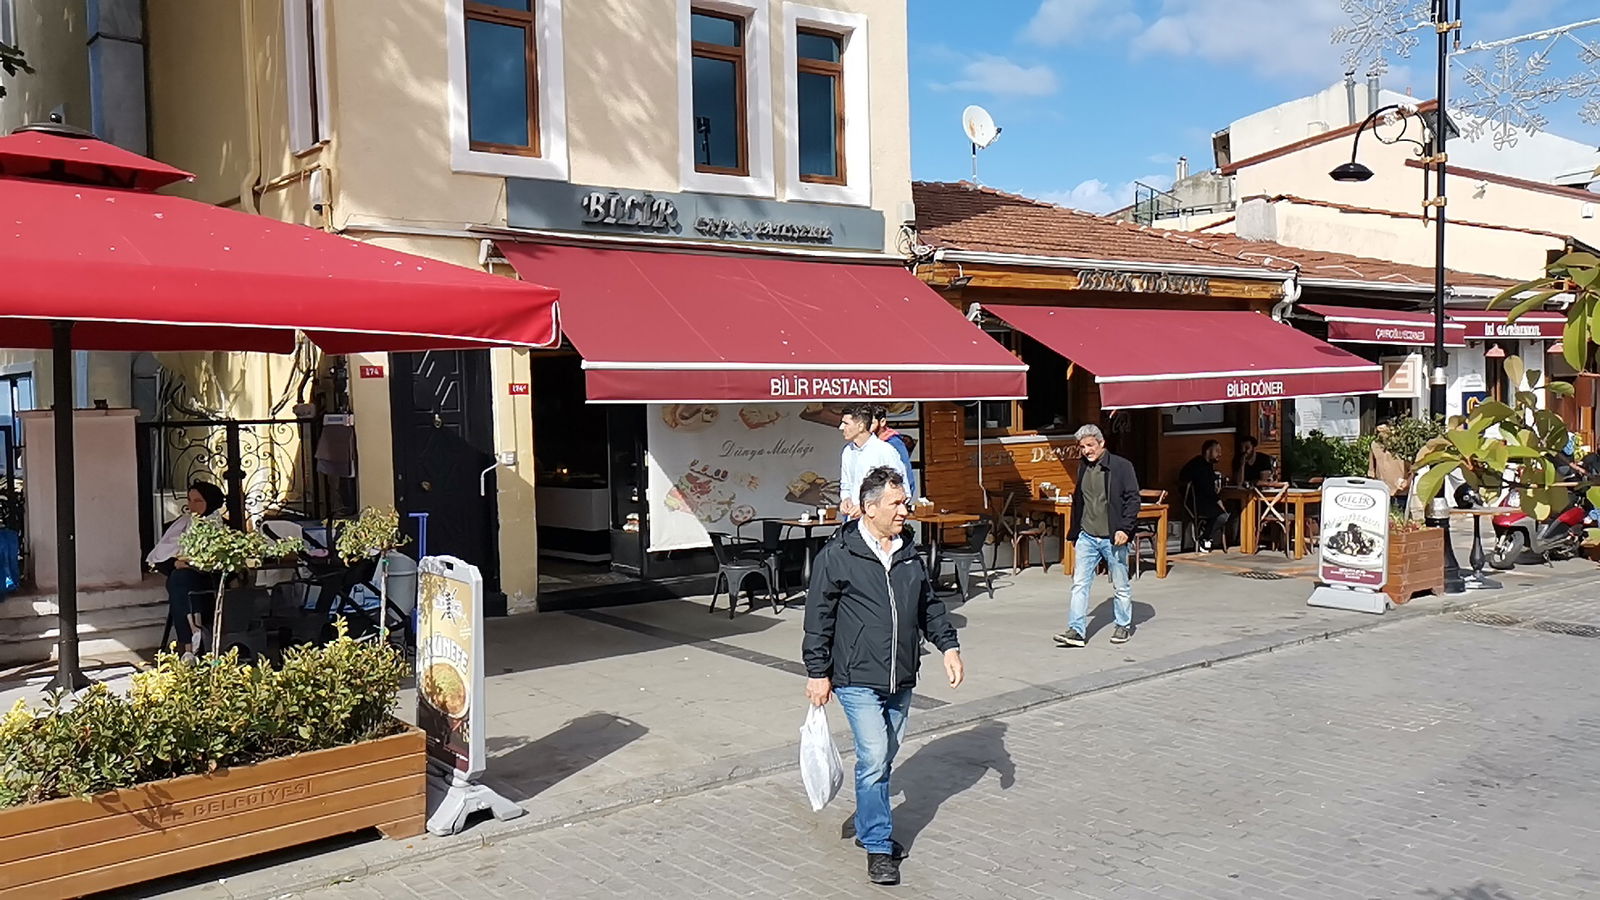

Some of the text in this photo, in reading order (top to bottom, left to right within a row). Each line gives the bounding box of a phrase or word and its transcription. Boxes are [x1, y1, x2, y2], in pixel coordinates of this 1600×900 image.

[365, 367, 380, 376] 174
[770, 375, 893, 396] BİLİR PASTANESİ
[1227, 379, 1284, 397] BİLİR DÖNER
[718, 439, 765, 461] Dünya
